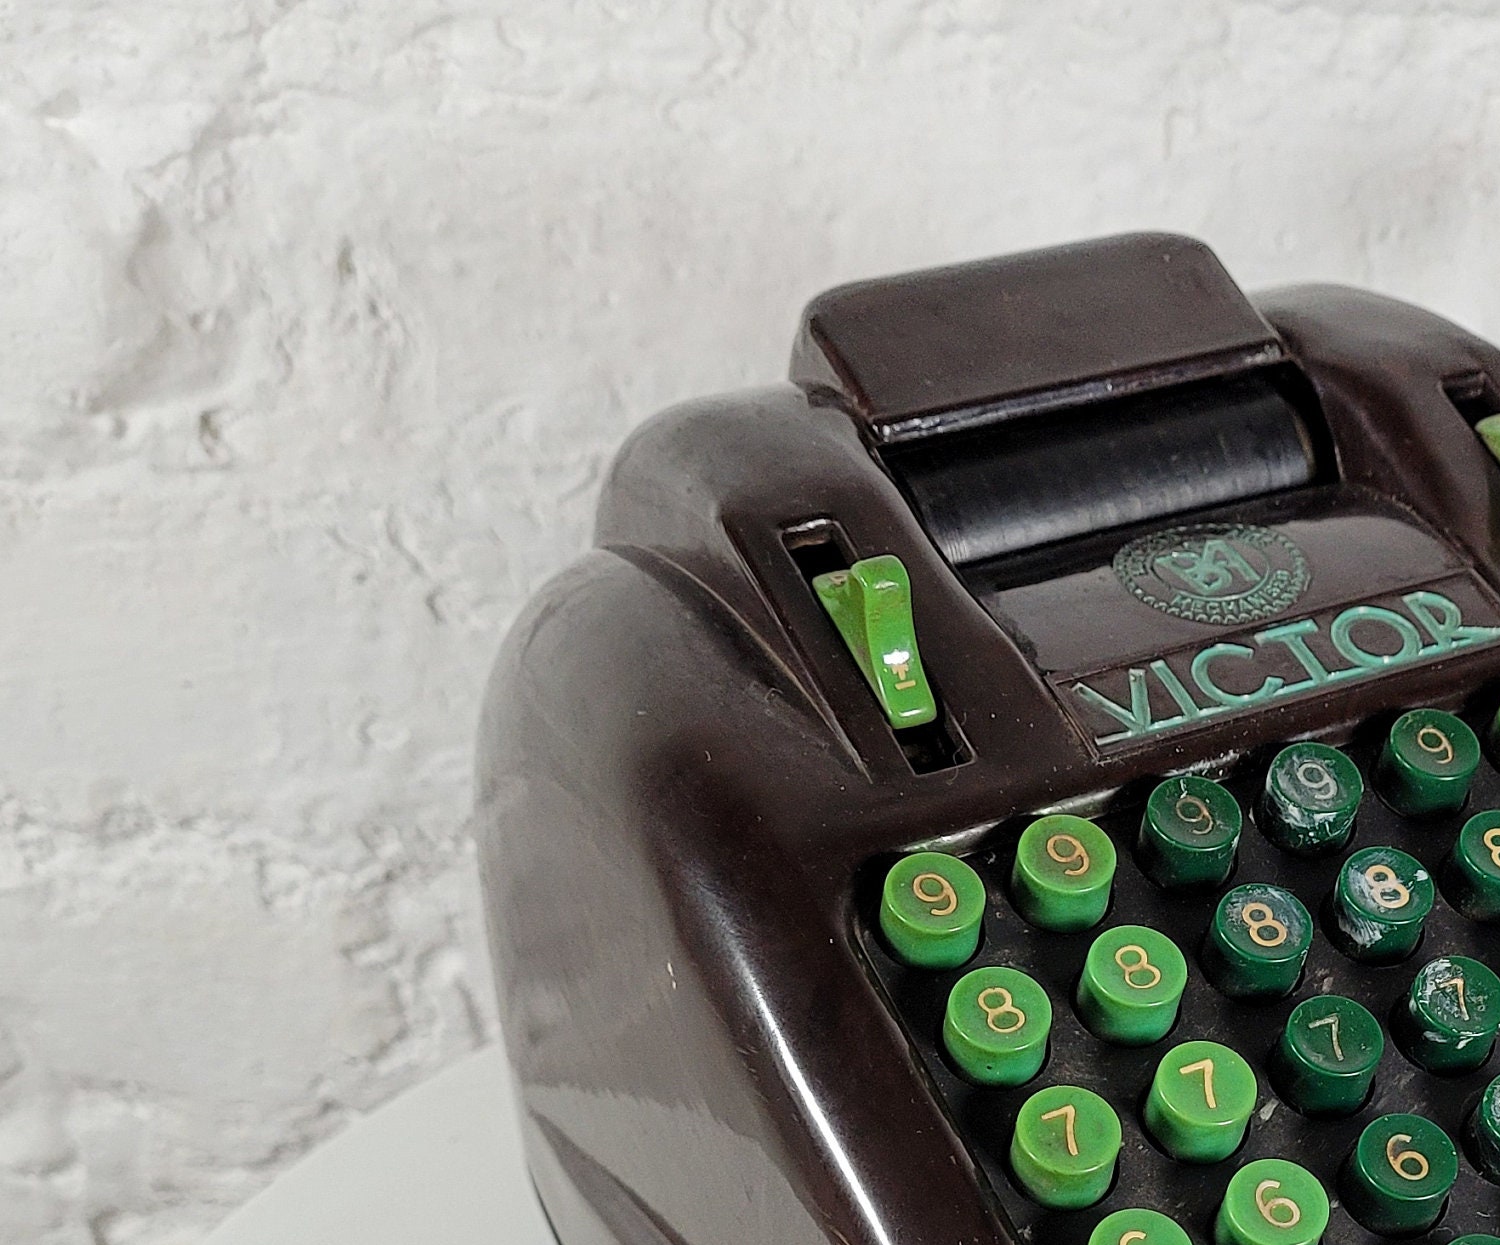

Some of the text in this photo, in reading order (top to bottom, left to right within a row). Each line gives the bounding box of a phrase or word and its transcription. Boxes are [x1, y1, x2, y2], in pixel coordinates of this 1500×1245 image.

[1417, 727, 1454, 764] 9
[1298, 762, 1336, 798] 9
[1175, 796, 1213, 835] 9
[1047, 834, 1090, 876] 9
[912, 873, 957, 916] 9
[1365, 865, 1409, 910] 8
[1241, 903, 1287, 947] 8
[1114, 944, 1162, 989] 8
[978, 987, 1025, 1033] 8
[1435, 977, 1469, 1021] 7
[1308, 1013, 1343, 1061] 7
[1179, 1059, 1217, 1109] 7
[1042, 1105, 1080, 1156] 7
[1386, 1134, 1429, 1181] 6
[1255, 1180, 1300, 1229] 6
